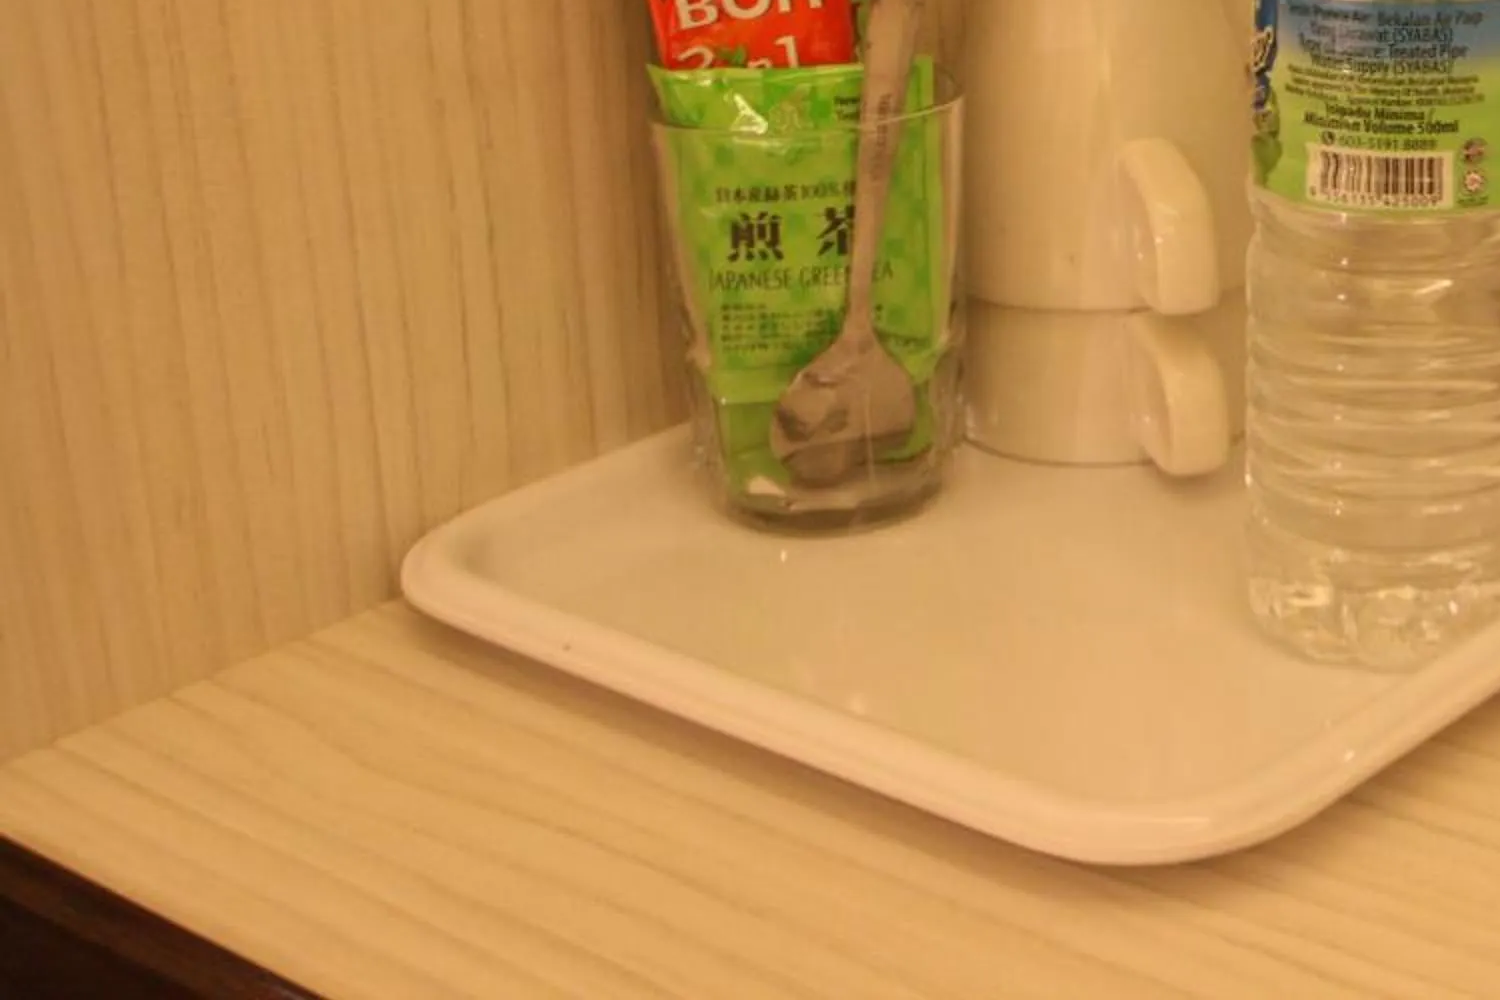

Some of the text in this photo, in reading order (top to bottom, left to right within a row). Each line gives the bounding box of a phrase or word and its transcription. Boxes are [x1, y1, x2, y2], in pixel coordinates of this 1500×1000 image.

[1363, 118, 1415, 135] Volume
[1416, 118, 1460, 135] 500ml
[799, 262, 852, 288] GREE
